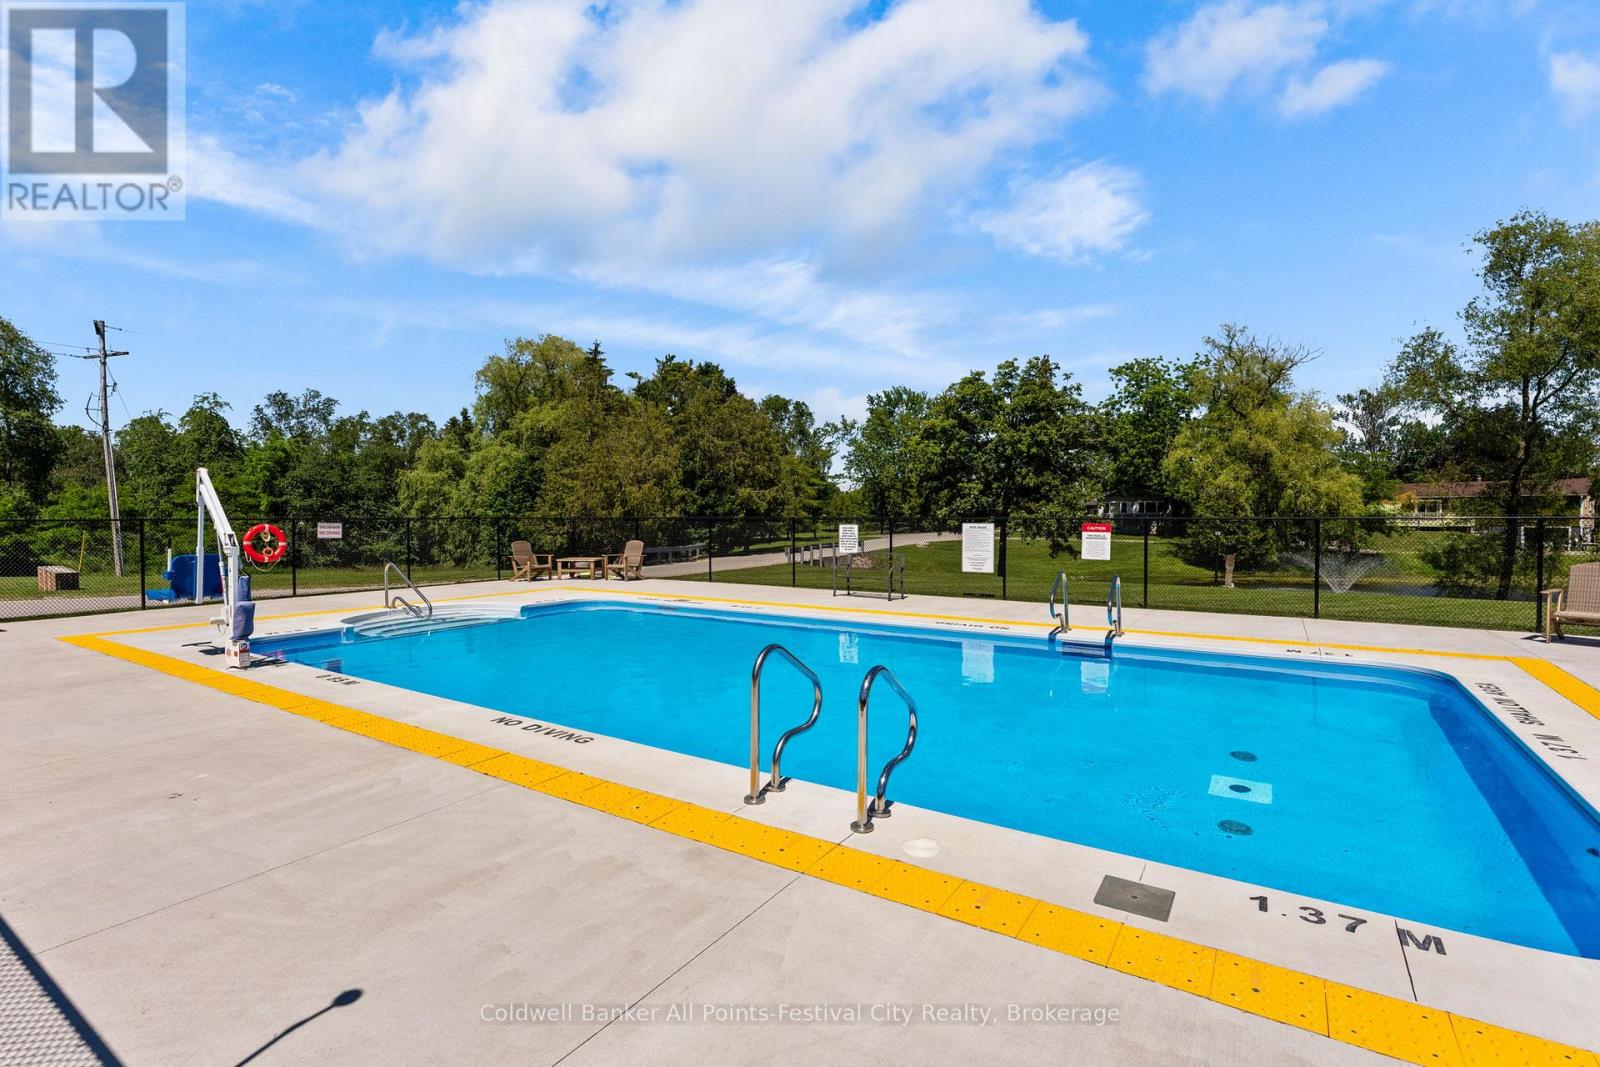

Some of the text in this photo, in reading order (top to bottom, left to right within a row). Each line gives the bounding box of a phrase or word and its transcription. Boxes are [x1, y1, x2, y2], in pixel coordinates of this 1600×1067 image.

[490, 716, 594, 745] NO DIVING
[1397, 928, 1447, 956] M
